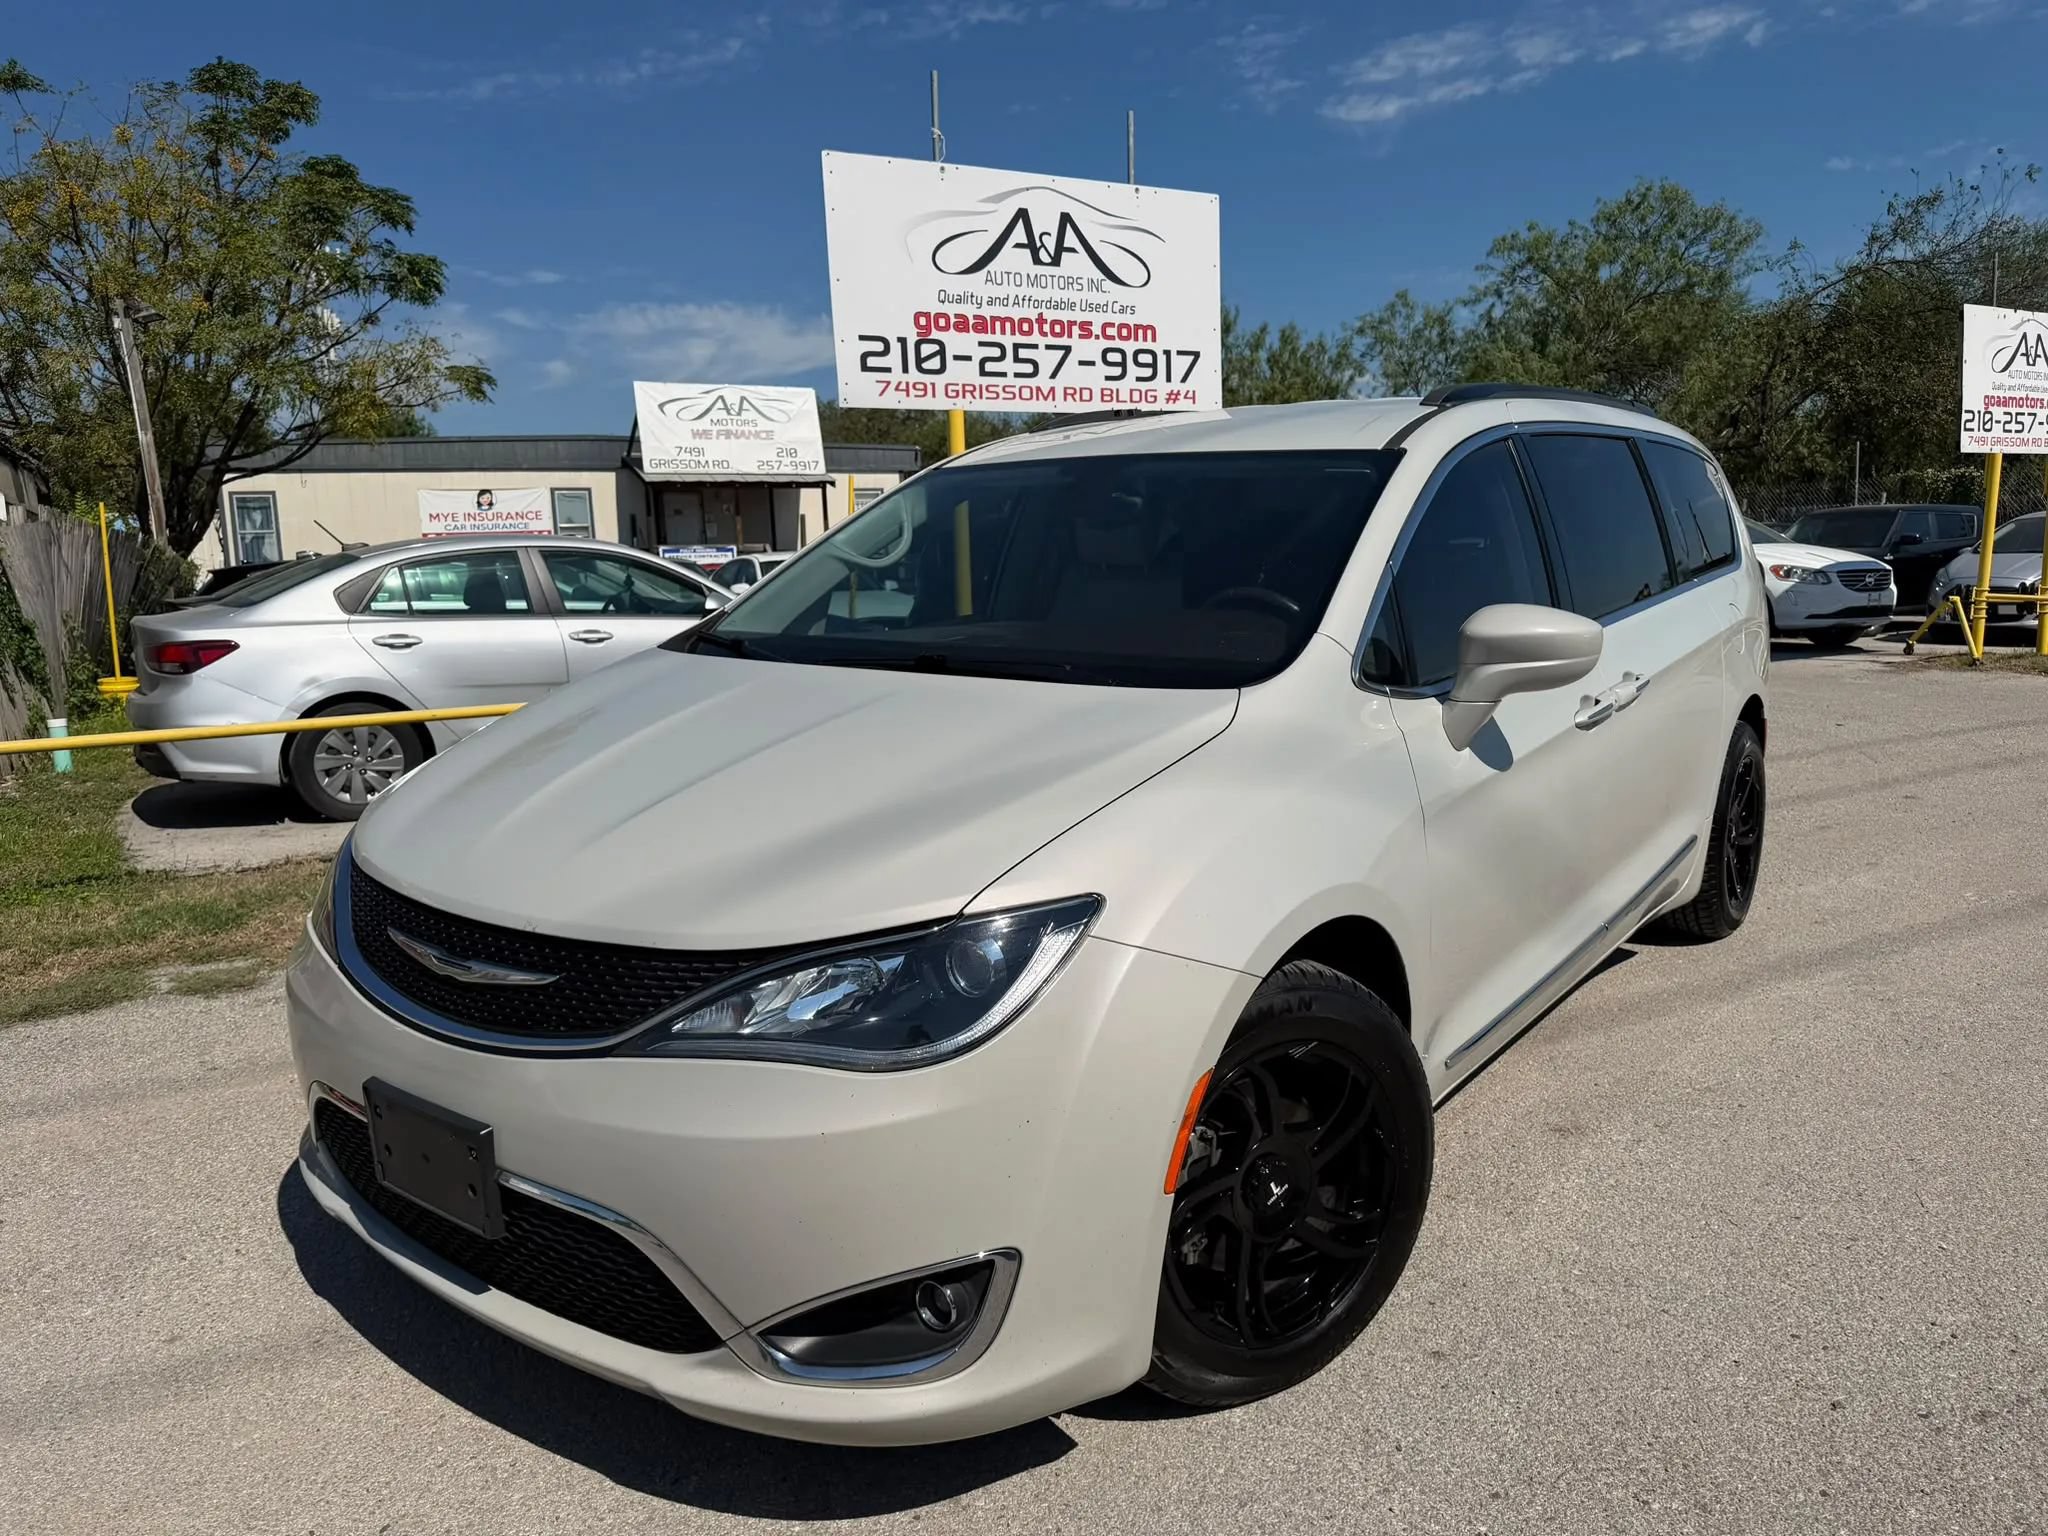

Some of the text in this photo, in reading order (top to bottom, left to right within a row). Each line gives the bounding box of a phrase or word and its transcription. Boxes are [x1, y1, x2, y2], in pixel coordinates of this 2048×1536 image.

[984, 270, 1111, 294] AUTO MOTORS INC.
[937, 289, 1136, 315] Quality and Affordable Used Cars
[913, 311, 1157, 342] goaamotors.com
[858, 335, 1201, 383] 210-257-9917
[2008, 369, 2022, 379] AUTO
[2023, 370, 2043, 381] MOTORS
[875, 380, 1197, 405] 7491 GRISSOM RD BLDG #4
[1991, 381, 2007, 393] Quality
[2008, 384, 2016, 392] and
[1983, 393, 2048, 410] goaamotors.
[710, 418, 758, 428] MOTORS
[1963, 409, 2048, 434] 210-257-
[691, 429, 775, 440] WE FINANCE
[1967, 435, 1989, 447] 7491
[1990, 436, 2030, 448] GRISSOM
[2031, 438, 2043, 448] RD
[674, 445, 706, 457] 7491
[776, 447, 798, 459] 210
[649, 459, 710, 470] GRISSOM
[756, 460, 820, 471] 257-9917
[429, 510, 543, 523] MYE INSURANCE
[444, 522, 530, 531] CAR INSURANCE
